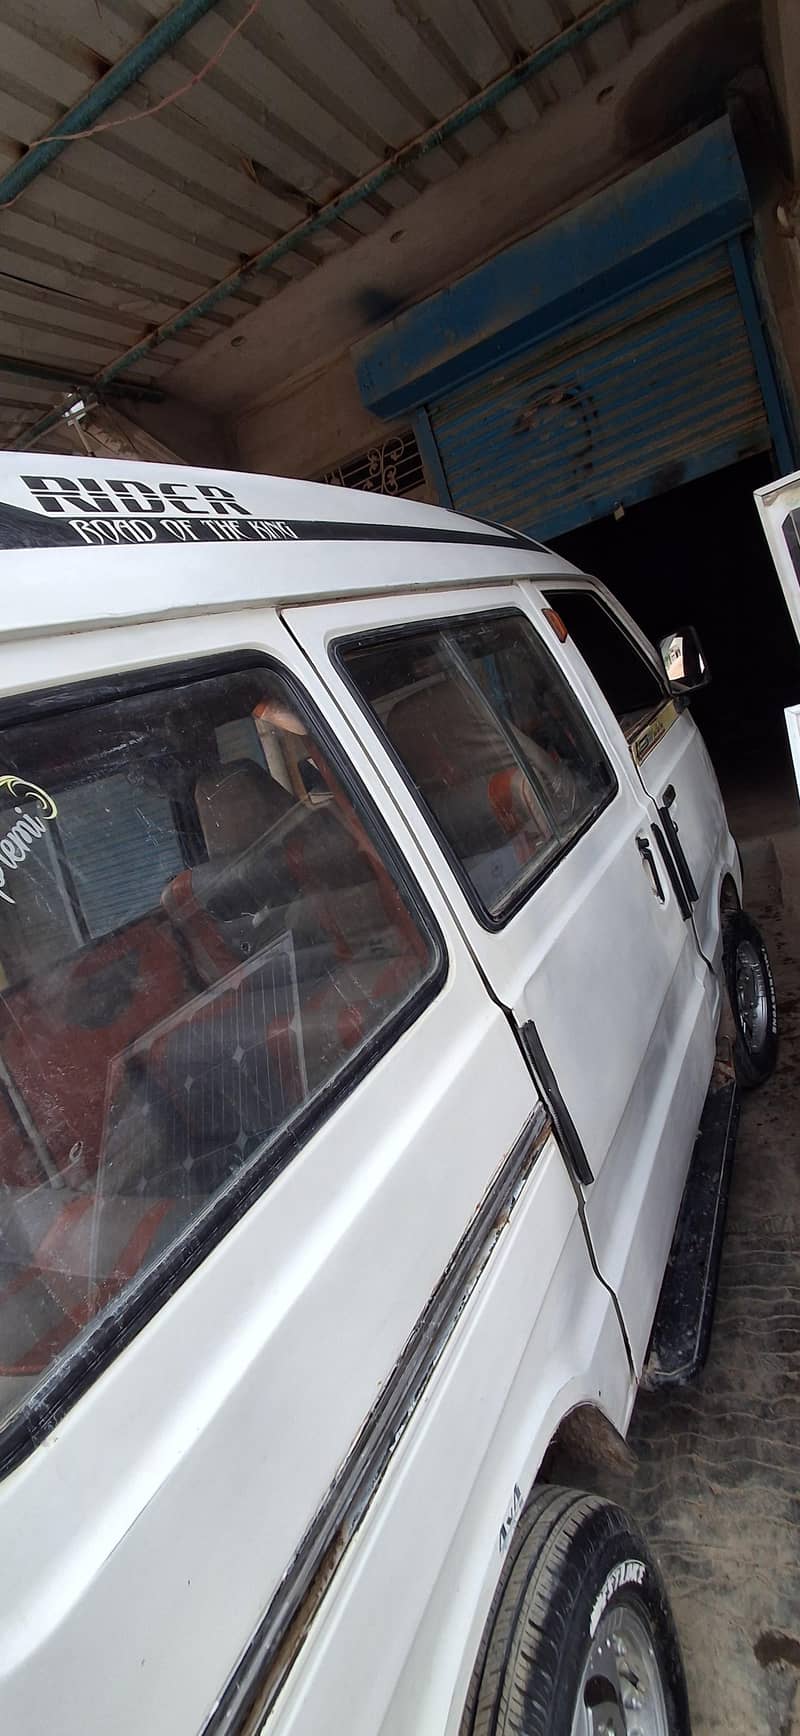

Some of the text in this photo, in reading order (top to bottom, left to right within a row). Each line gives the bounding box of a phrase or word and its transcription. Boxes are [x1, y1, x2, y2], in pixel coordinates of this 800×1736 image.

[20, 475, 252, 515] RIDER
[68, 518, 298, 544] ROAD OF THE KING
